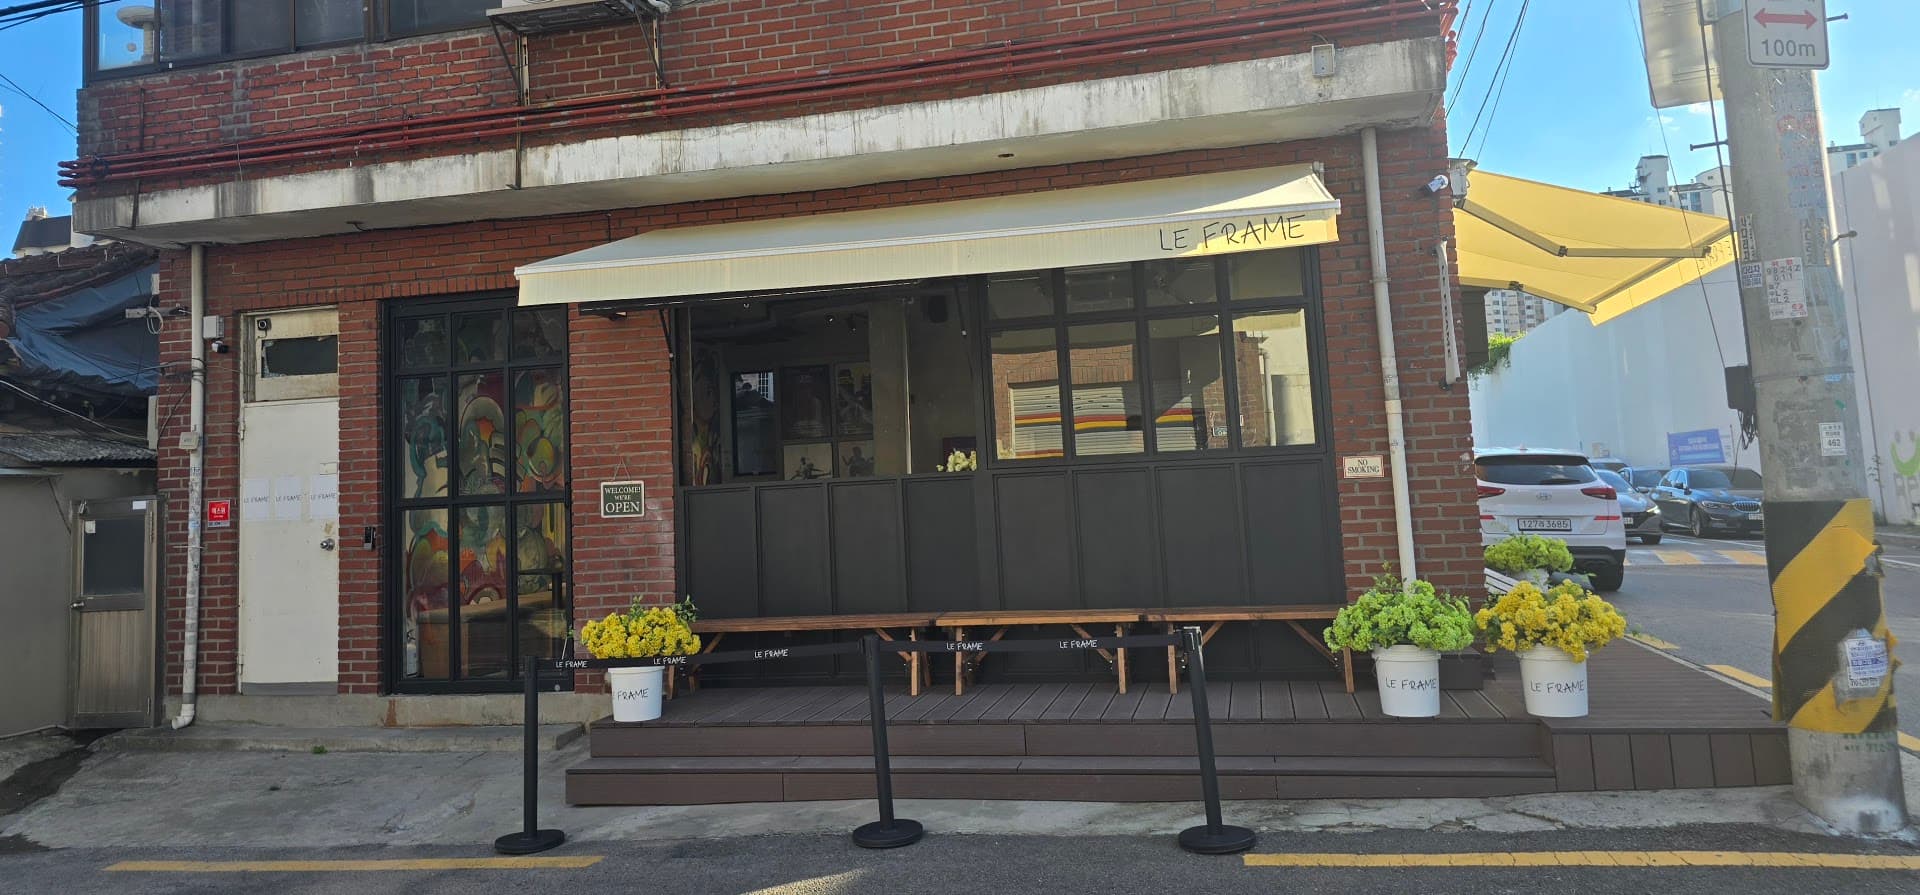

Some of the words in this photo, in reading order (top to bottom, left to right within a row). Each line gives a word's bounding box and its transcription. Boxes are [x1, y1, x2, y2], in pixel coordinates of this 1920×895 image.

[1761, 39, 1816, 57] 100m
[1159, 228, 1190, 251] LE
[1203, 214, 1306, 249] FRAME
[1347, 465, 1380, 474] SMOKING
[250, 495, 269, 503] FRAME
[317, 492, 336, 500] FRAME
[605, 501, 641, 513] OPEN
[946, 642, 955, 650] LE
[957, 642, 984, 651] FRAME
[1059, 640, 1068, 649] LE
[1070, 639, 1098, 648] FRAME
[754, 650, 763, 659] LE
[764, 648, 789, 659] FRAME
[555, 661, 563, 669] LE
[565, 660, 589, 668] FRAME
[662, 656, 688, 665] FRAME
[1385, 677, 1396, 689] LE
[1401, 677, 1437, 691] FRAME
[1530, 680, 1541, 692] LE
[1546, 679, 1585, 694] FRAME
[617, 687, 649, 701] FRAME
